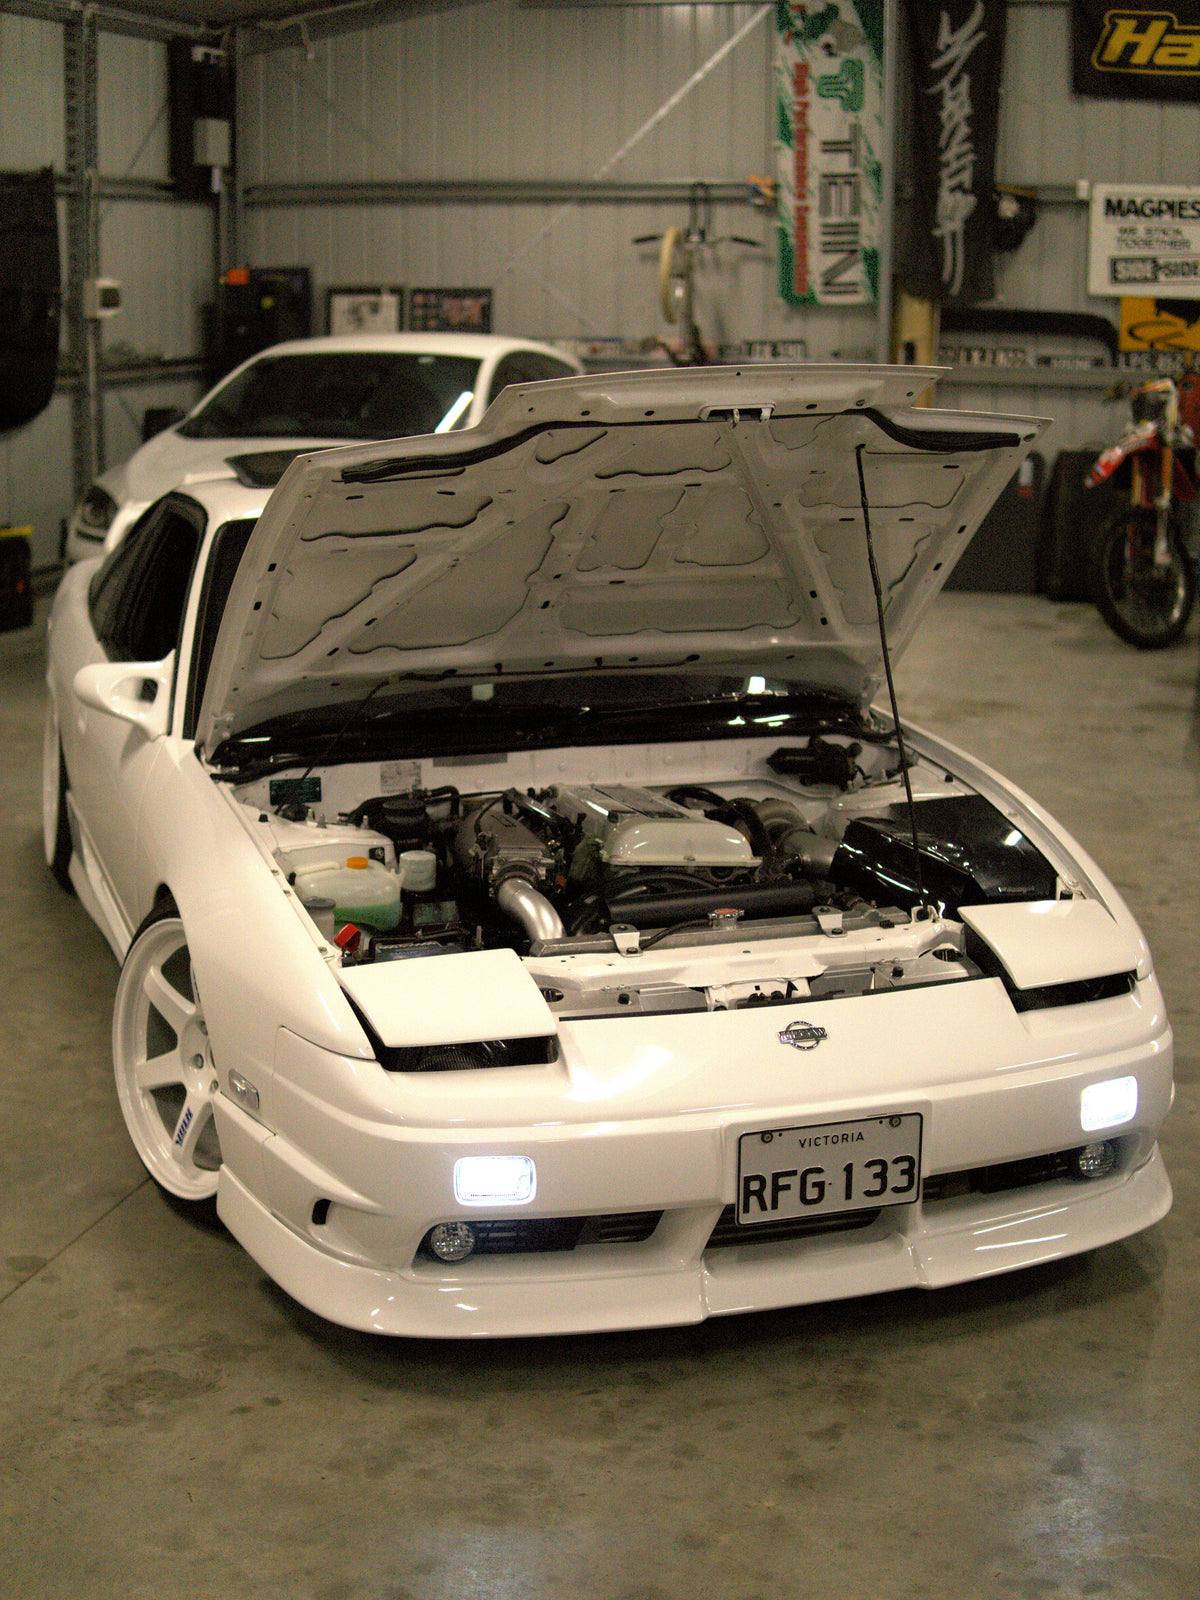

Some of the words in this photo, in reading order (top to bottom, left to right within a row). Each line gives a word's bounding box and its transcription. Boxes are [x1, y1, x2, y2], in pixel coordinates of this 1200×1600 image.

[819, 123, 862, 294] TEIN
[1104, 198, 1200, 219] MAGPIES
[798, 1131, 865, 1149] VICTORIA
